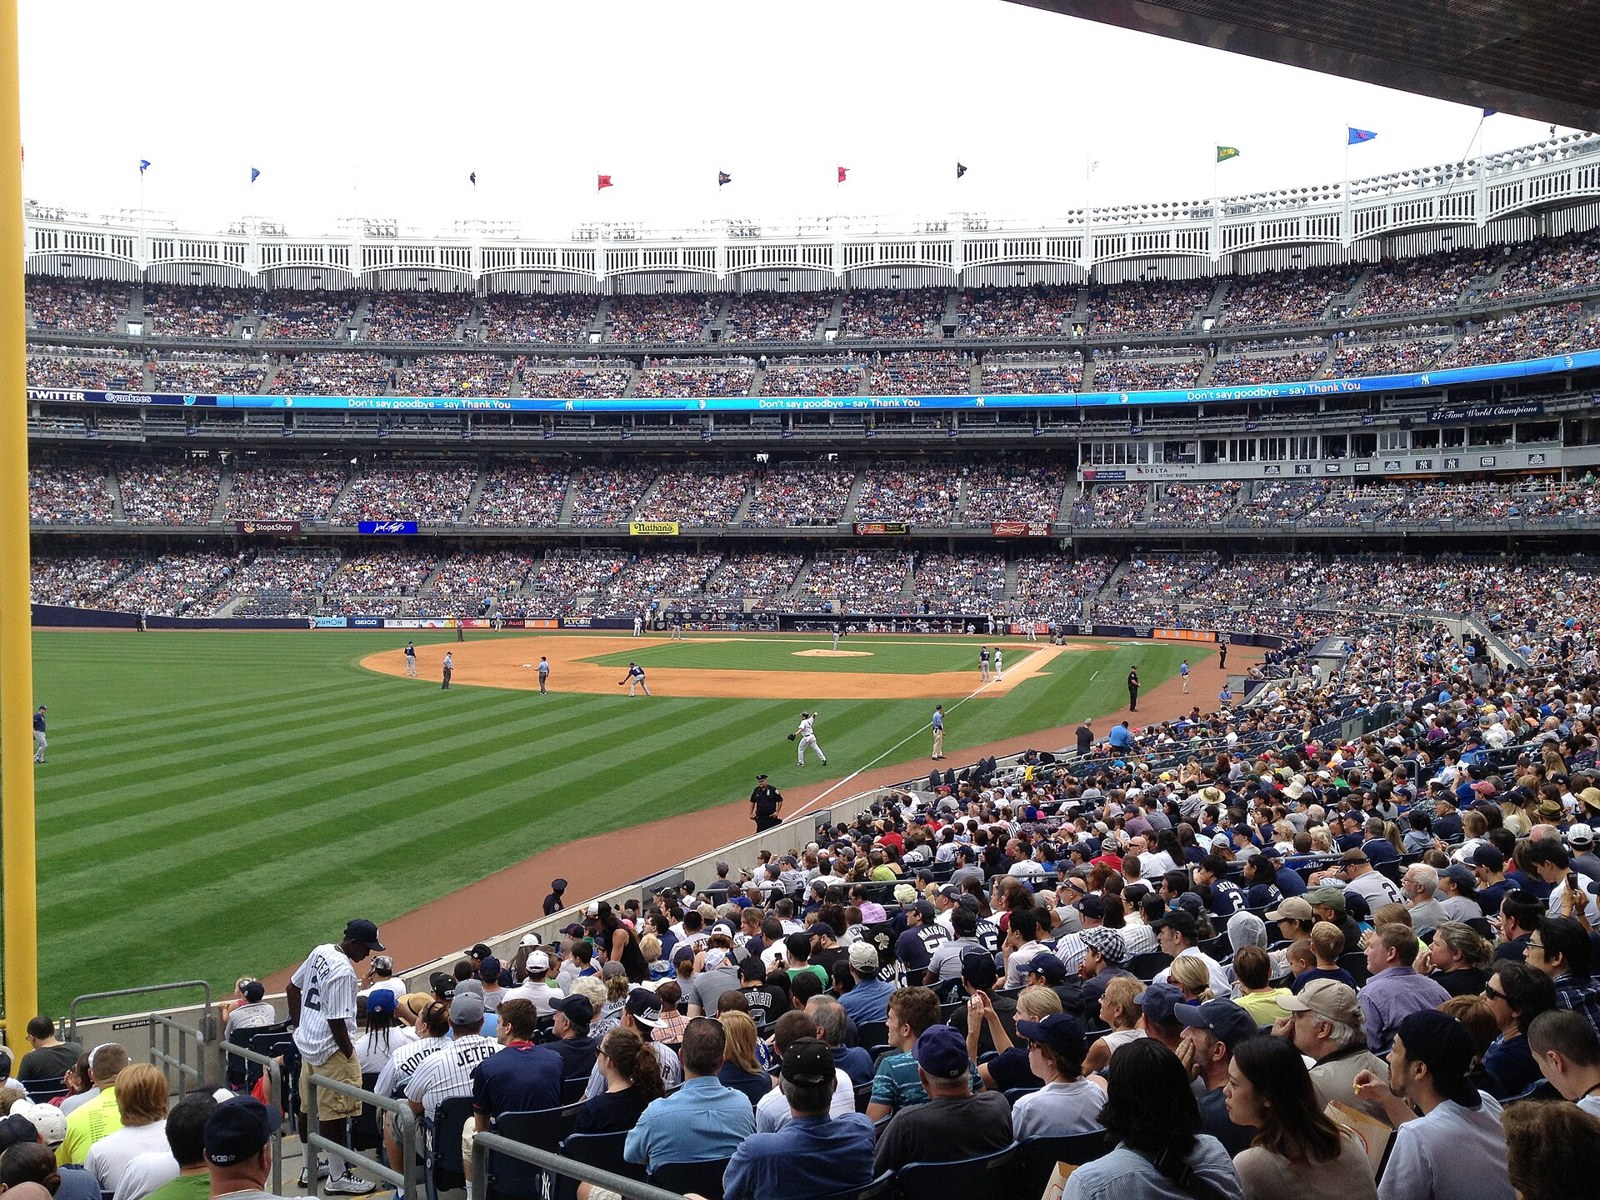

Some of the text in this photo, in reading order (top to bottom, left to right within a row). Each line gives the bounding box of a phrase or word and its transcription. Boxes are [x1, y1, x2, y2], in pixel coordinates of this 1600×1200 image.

[28, 390, 85, 401] TWITTER
[1187, 392, 1214, 400] Don't
[1216, 391, 1232, 400] say
[1234, 387, 1278, 400] goodbye
[1288, 386, 1306, 396] say
[1308, 383, 1340, 394] Thank
[1342, 382, 1361, 391] You
[348, 398, 374, 408] Don't
[376, 401, 392, 409] say
[394, 399, 434, 408] goodbye
[444, 401, 460, 409] say
[461, 400, 490, 408] Thank
[492, 400, 511, 409] You
[759, 400, 784, 408] Don't
[786, 402, 801, 410] say
[803, 400, 844, 410] goodbye
[870, 399, 900, 407] Thank
[1466, 407, 1492, 418] World
[1494, 406, 1538, 417] Champions
[256, 523, 292, 532] Stop&Shop
[634, 522, 674, 533] Nathan's
[1382, 882, 1402, 904] 2
[1228, 891, 1246, 910] 2
[985, 936, 998, 951] 5
[304, 975, 321, 1012] 2
